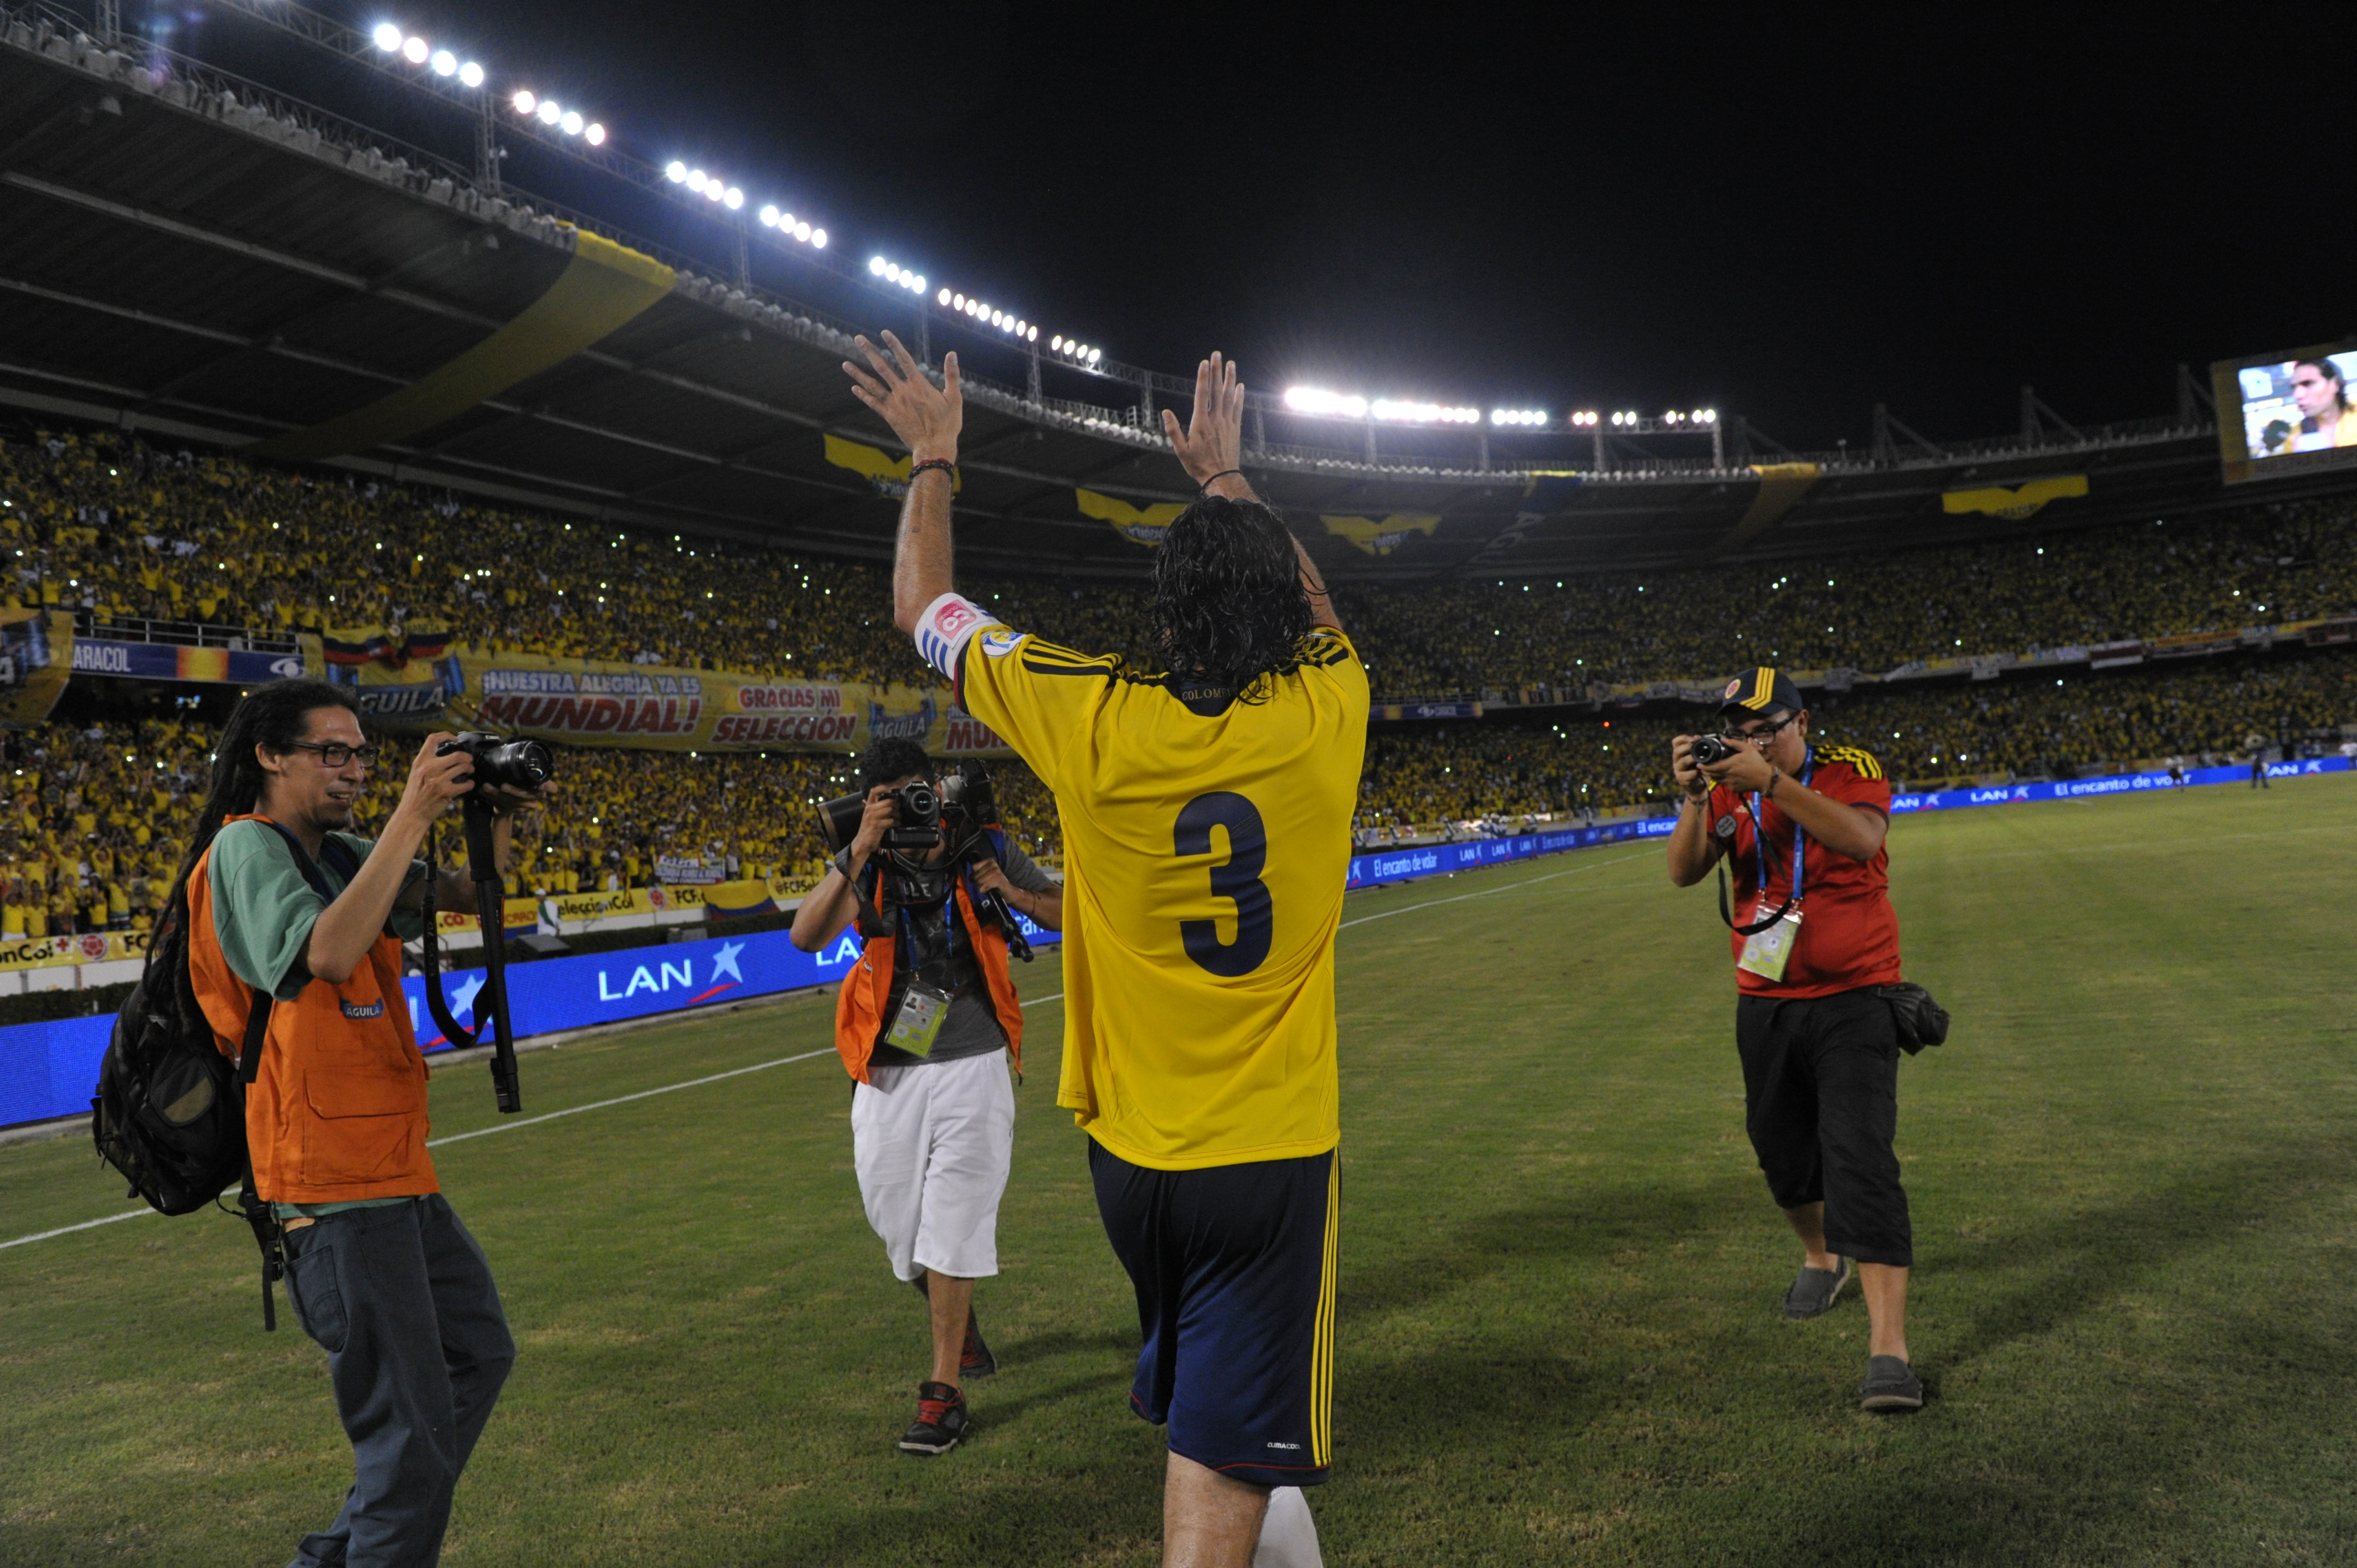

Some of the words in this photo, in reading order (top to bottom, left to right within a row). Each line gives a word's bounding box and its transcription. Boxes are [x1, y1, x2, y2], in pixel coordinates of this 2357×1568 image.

[73, 645, 131, 672] ARACOL
[656, 675, 678, 694] YA
[682, 676, 701, 694] ES
[359, 686, 444, 713] GUILA
[739, 688, 815, 708] GRACIAS
[820, 688, 841, 708] MI
[480, 695, 699, 734] MUNDIAL!
[711, 709, 856, 742] SELECCIÓN
[2267, 764, 2298, 777] AN
[1970, 787, 2008, 802] LAN
[2054, 783, 2068, 796] El
[2071, 779, 2130, 795] encanto
[2132, 775, 2151, 788] de
[1891, 797, 1919, 809] AN
[1459, 849, 1475, 862] LAN
[1491, 845, 1506, 857] LAN
[1374, 859, 1382, 878] El
[1383, 858, 1412, 876] encanto
[1412, 853, 1421, 871] de
[1421, 852, 1437, 869] volar
[1173, 791, 1273, 977] 3
[599, 958, 692, 1001] LAN
[347, 1007, 380, 1017] AGUILA
